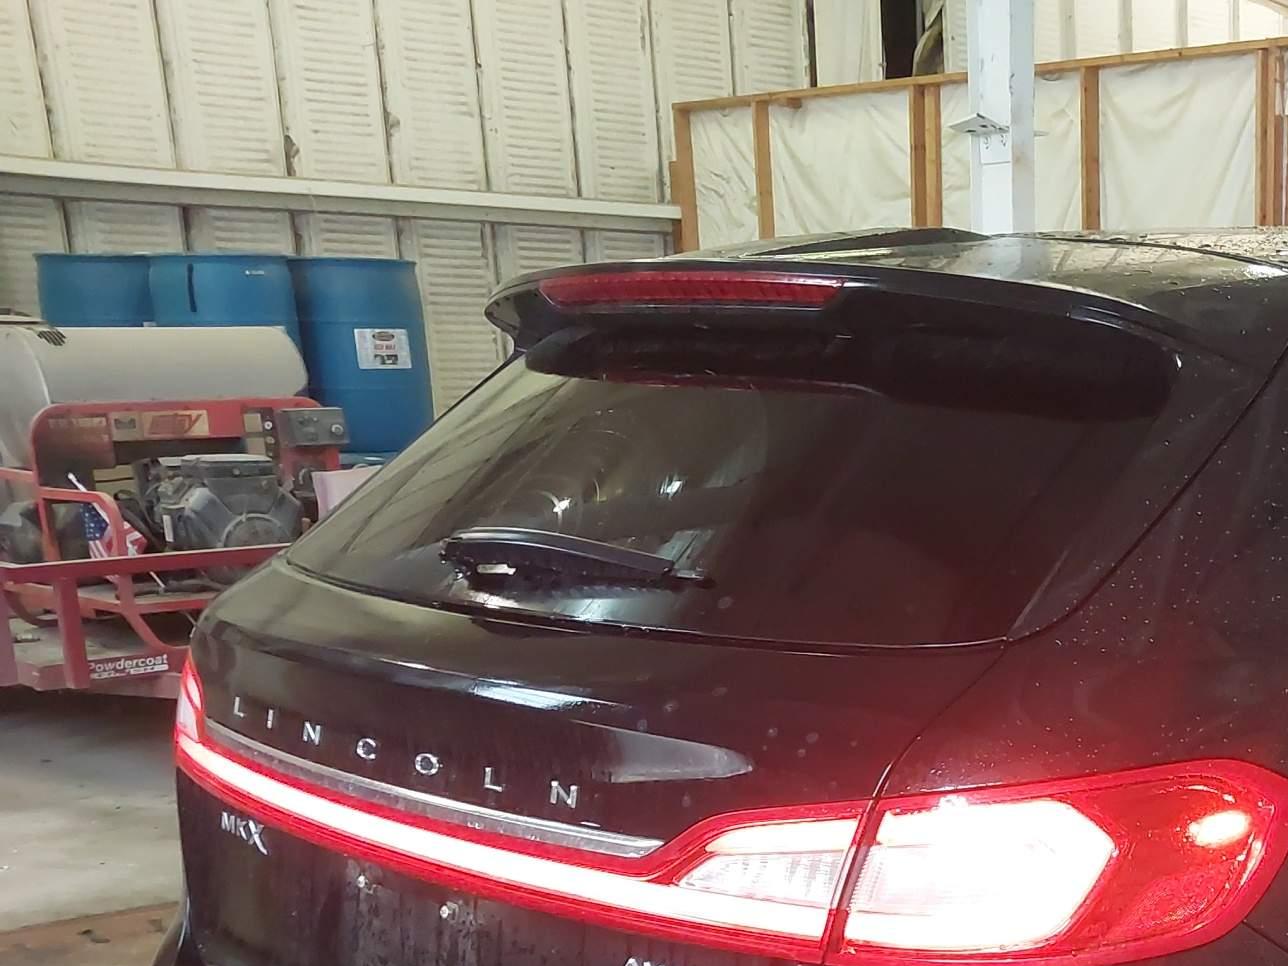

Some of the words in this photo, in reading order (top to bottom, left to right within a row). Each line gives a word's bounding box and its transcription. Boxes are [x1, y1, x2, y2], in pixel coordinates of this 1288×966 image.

[88, 653, 168, 672] Powdercoat
[233, 696, 579, 809] LINCOLN
[220, 811, 268, 855] MKX
